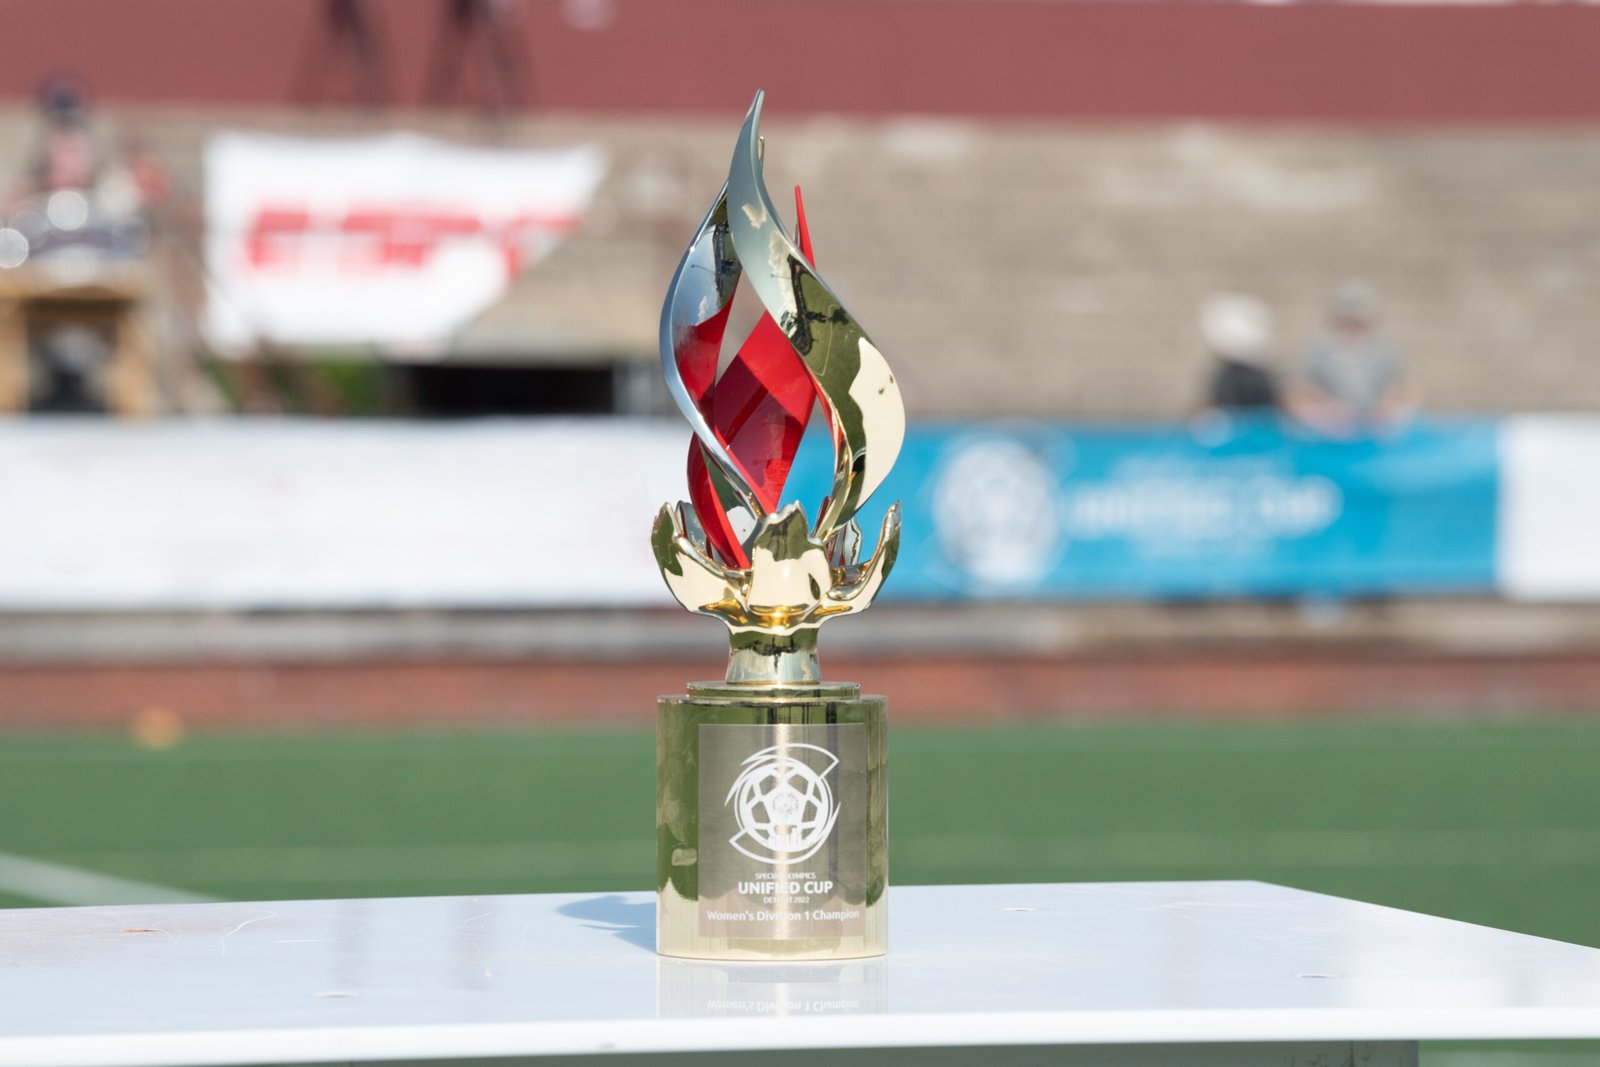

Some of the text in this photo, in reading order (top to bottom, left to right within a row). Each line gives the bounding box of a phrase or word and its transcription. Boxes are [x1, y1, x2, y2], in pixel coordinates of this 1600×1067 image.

[737, 881, 833, 894] UNIFIED CUP
[793, 896, 810, 904] 2022
[707, 910, 754, 921] Women's
[804, 911, 810, 920] 1
[812, 909, 860, 921] Champion
